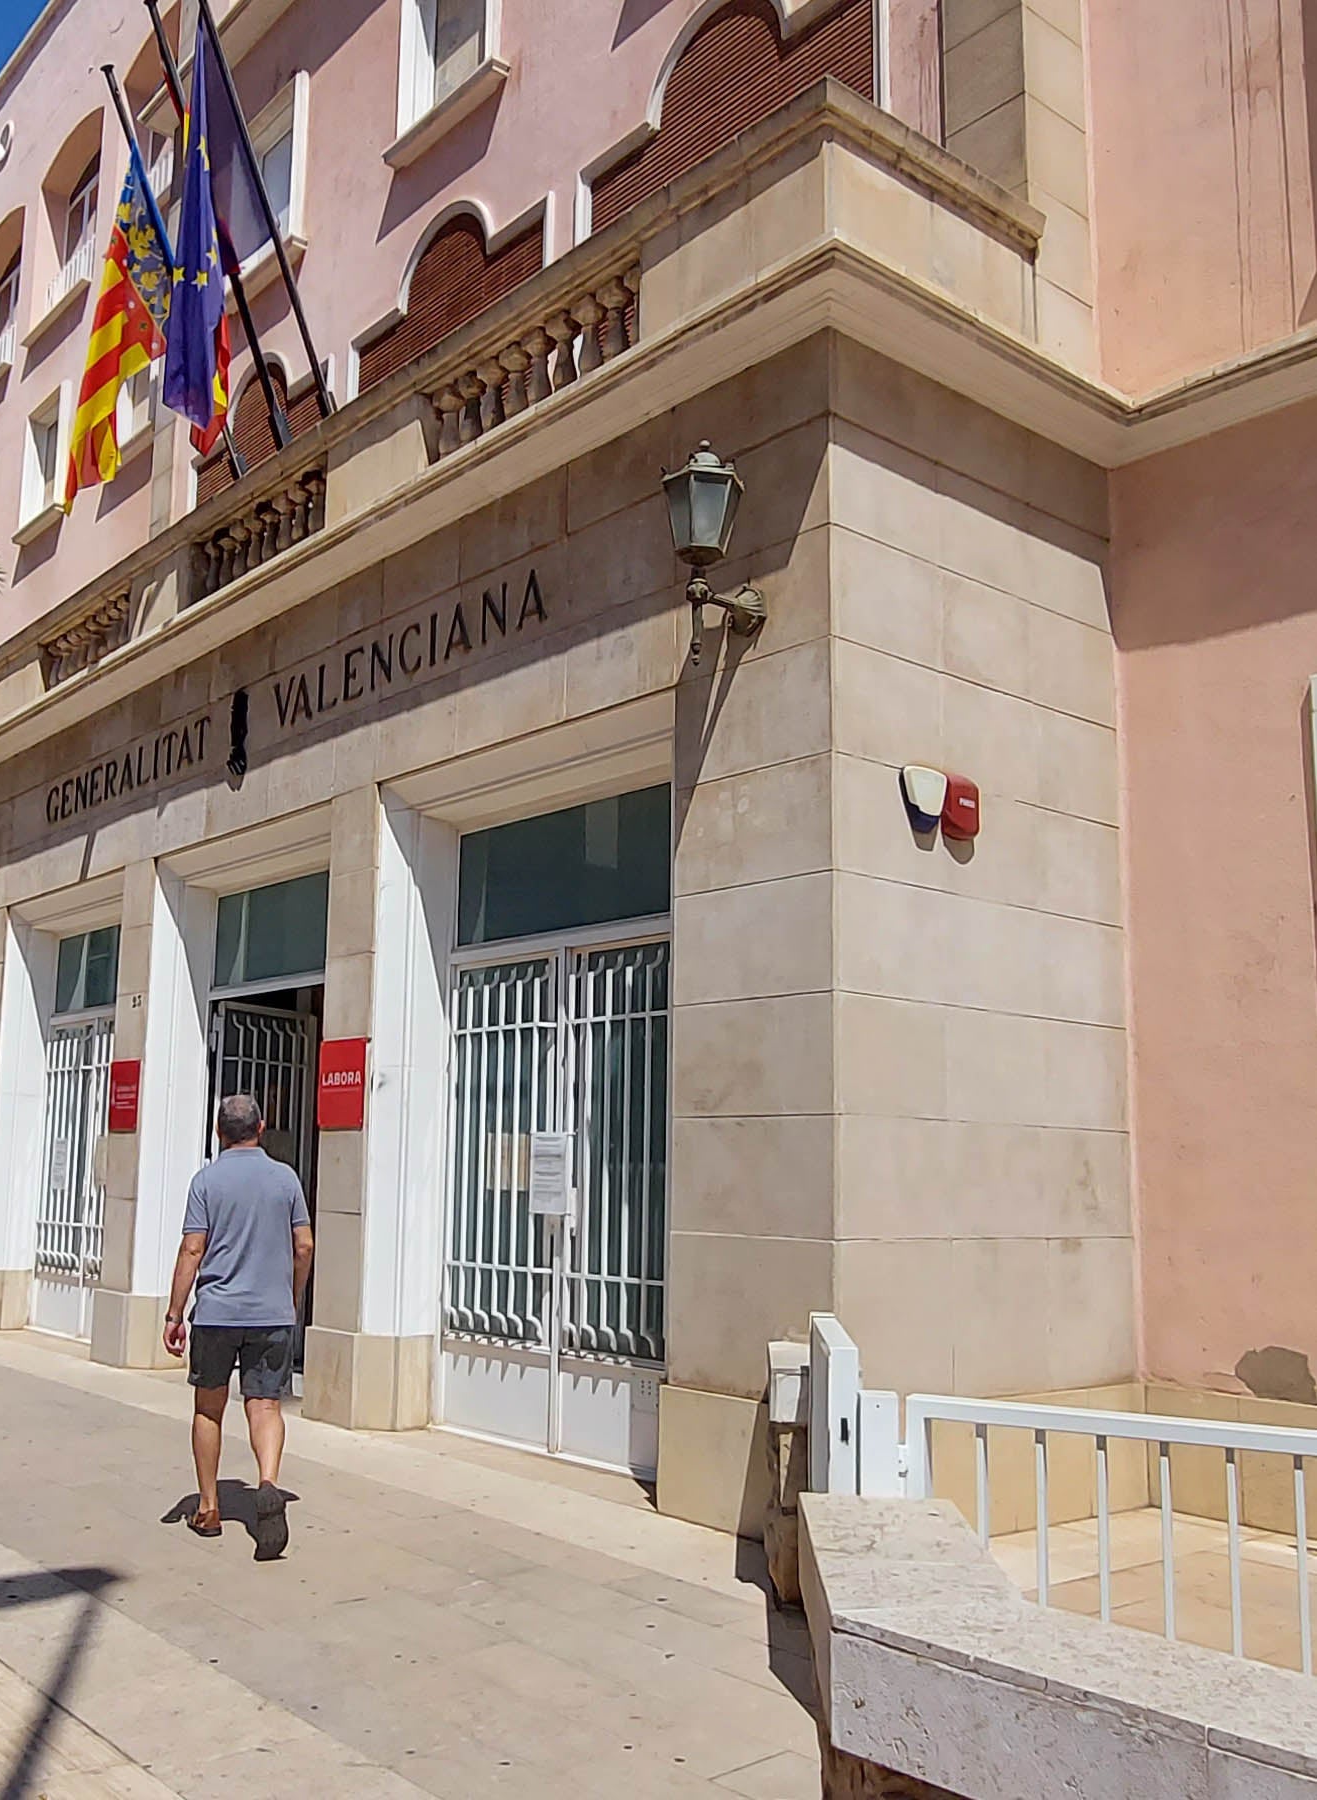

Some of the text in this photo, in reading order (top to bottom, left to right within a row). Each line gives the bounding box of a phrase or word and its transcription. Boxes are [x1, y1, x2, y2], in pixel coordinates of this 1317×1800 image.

[46, 568, 549, 824] GENERALITAT VALENCIANA
[322, 1070, 362, 1086] LABORA
